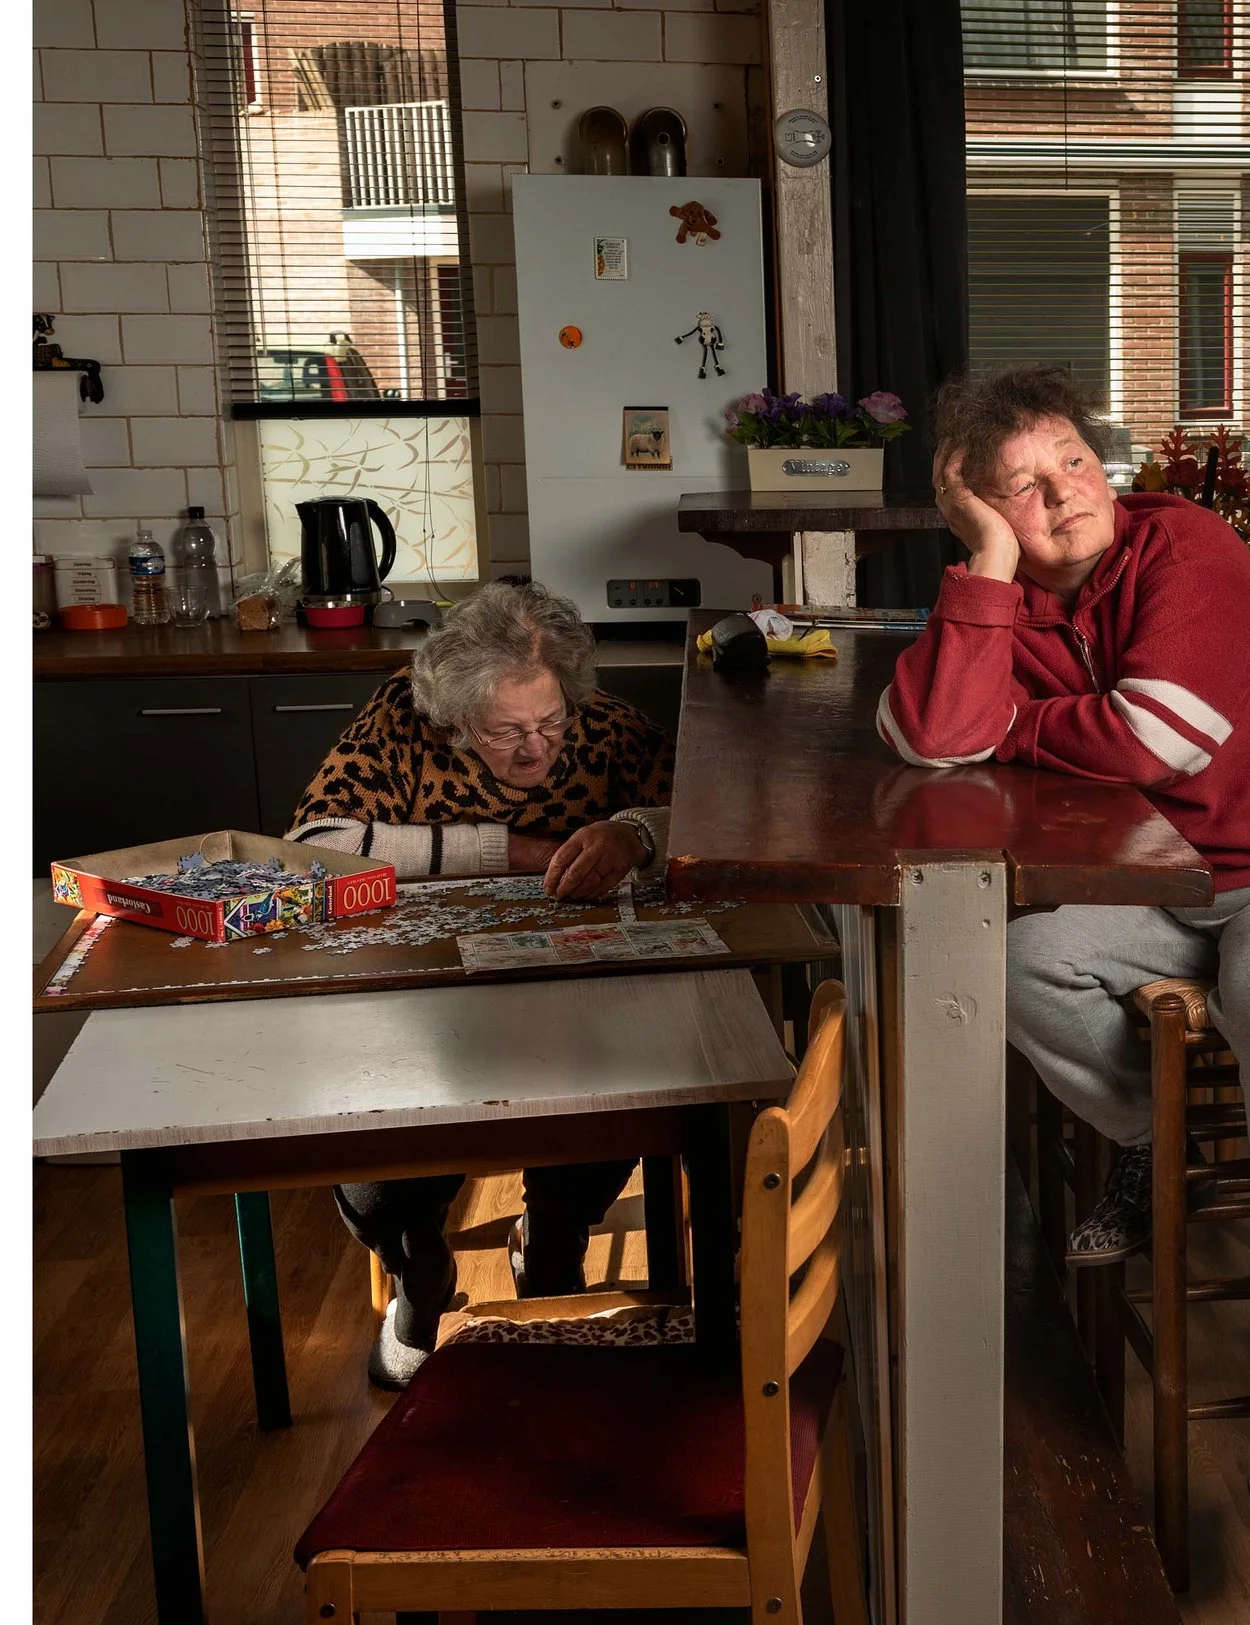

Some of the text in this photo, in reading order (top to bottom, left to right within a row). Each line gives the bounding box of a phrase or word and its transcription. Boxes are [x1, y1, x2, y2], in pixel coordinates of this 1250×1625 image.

[787, 460, 844, 475] Vintage
[106, 892, 151, 914] Castorland
[343, 877, 392, 910] 1000
[176, 905, 215, 936] 1000
